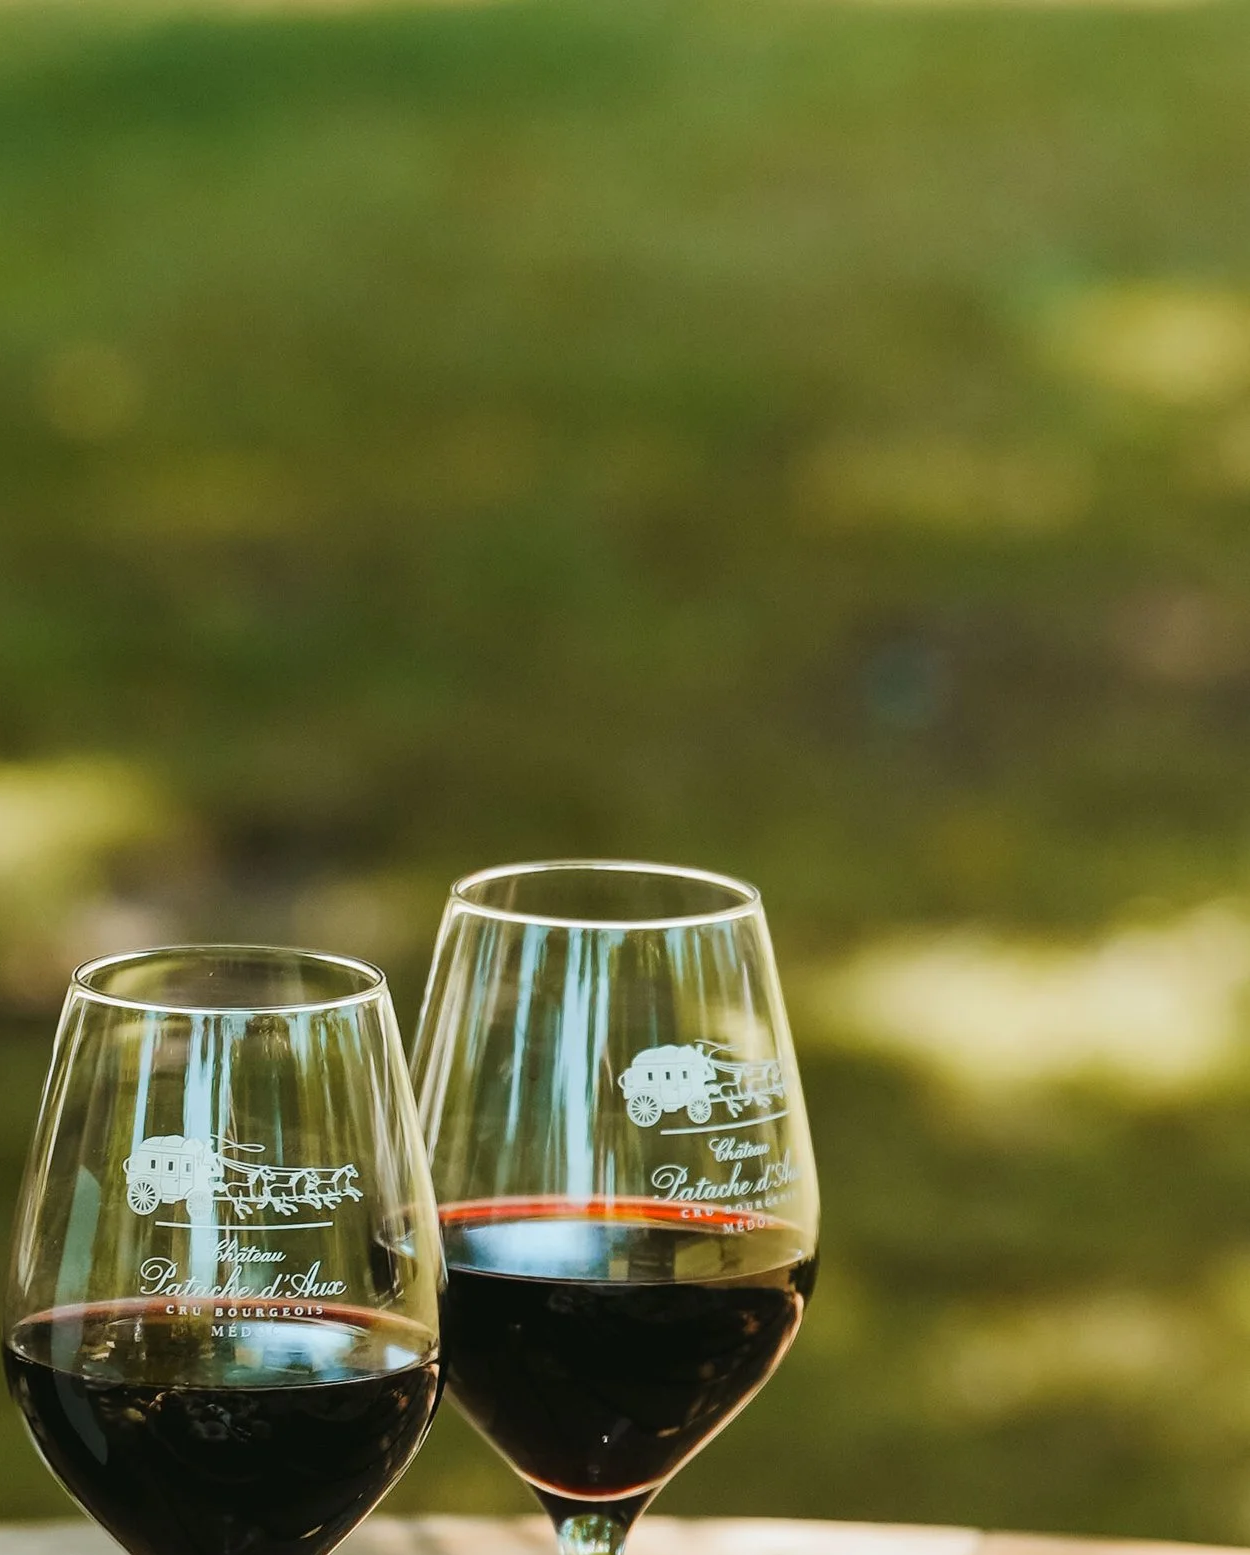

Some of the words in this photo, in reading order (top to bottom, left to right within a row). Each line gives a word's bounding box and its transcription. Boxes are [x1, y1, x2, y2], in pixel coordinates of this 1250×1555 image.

[708, 1137, 770, 1162] Château
[651, 1162, 753, 1202] Patache
[681, 1206, 715, 1219] CRU
[723, 1214, 774, 1235] MÉDO
[212, 1239, 287, 1264] Château
[140, 1257, 255, 1300] Patache
[253, 1261, 347, 1300] d'Aux
[165, 1304, 201, 1317] CRU
[214, 1305, 324, 1318] BOURGEOIS
[211, 1323, 279, 1338] MÉD
